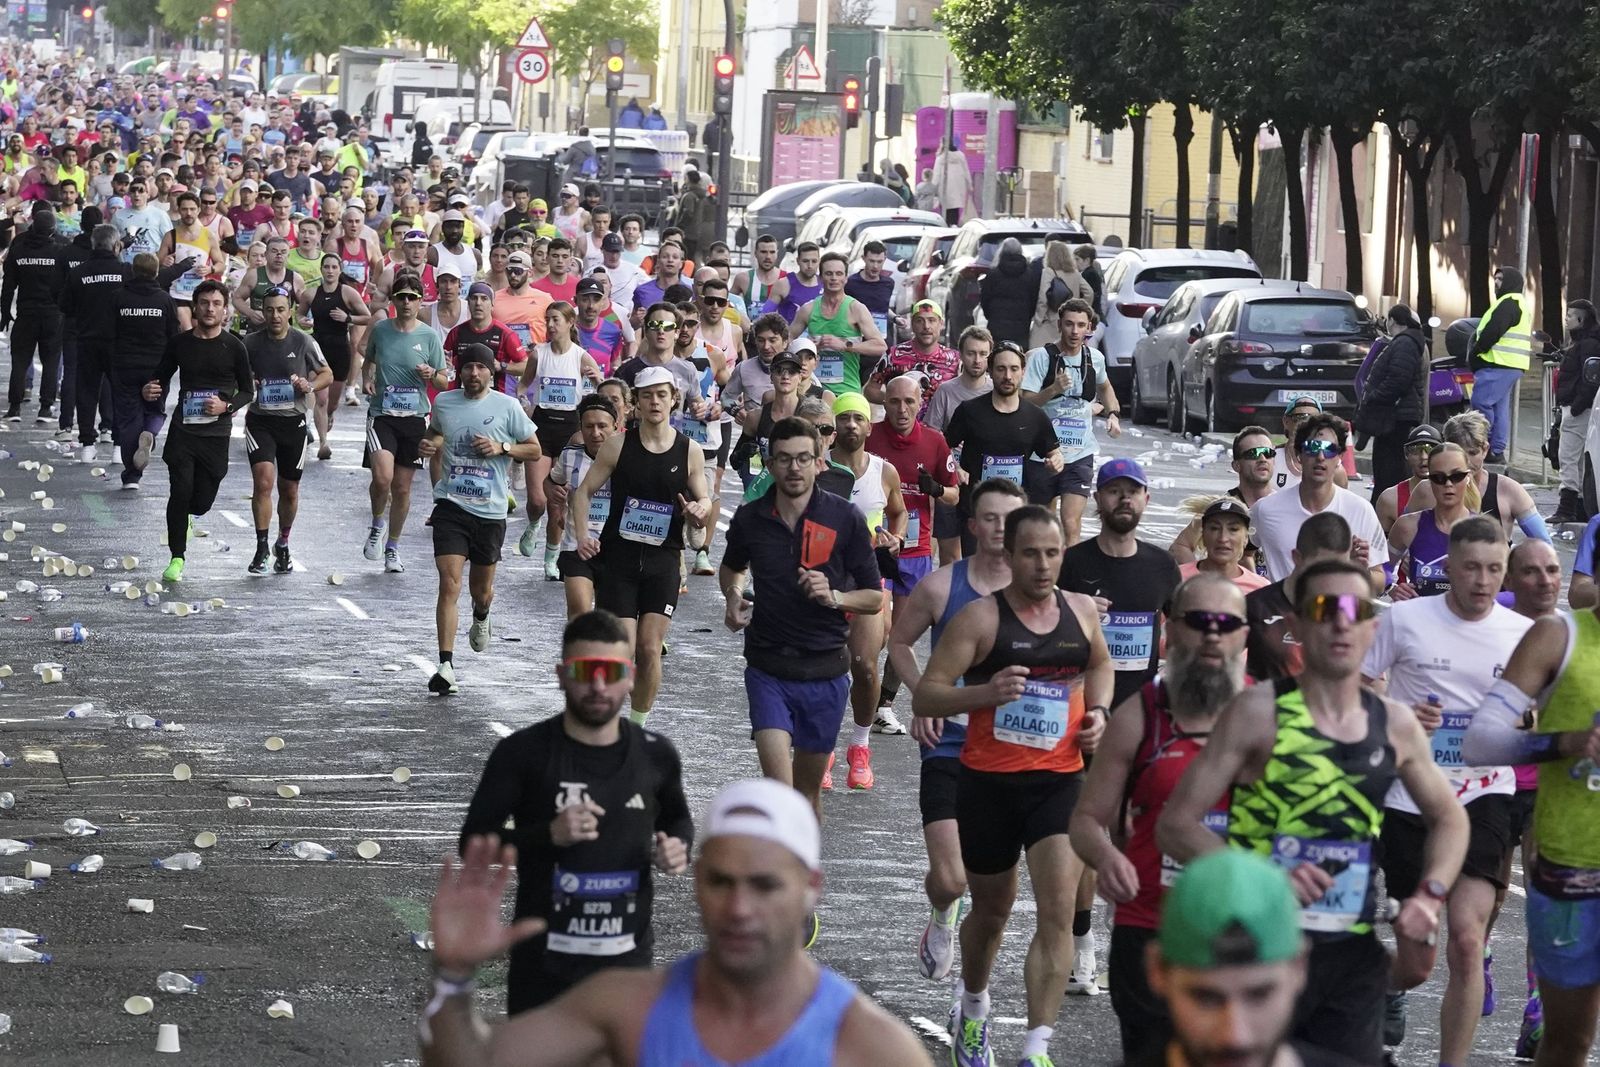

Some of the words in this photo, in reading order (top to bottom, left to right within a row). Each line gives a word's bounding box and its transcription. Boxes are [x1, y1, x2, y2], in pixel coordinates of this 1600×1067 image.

[523, 60, 543, 72] 30
[16, 258, 56, 266] VOLUNTEER
[82, 274, 122, 284] VOLUNTEER
[119, 308, 163, 317] VOLUNTEER
[262, 395, 289, 403] LUISMA
[548, 395, 567, 403] BEGO
[390, 402, 412, 410] JORGE
[1058, 437, 1083, 446] GUSTIN
[465, 468, 489, 477] ZURICH
[456, 486, 483, 497] NACHO
[641, 502, 669, 513] ZURICH
[639, 514, 654, 523] 5847
[625, 520, 664, 536] CHARLIE
[1114, 615, 1148, 624] ZURICH
[1025, 684, 1063, 698] ZURICH
[1003, 713, 1060, 735] PALACIO
[583, 876, 632, 890] ZURICH
[566, 916, 623, 936] ALLAN
